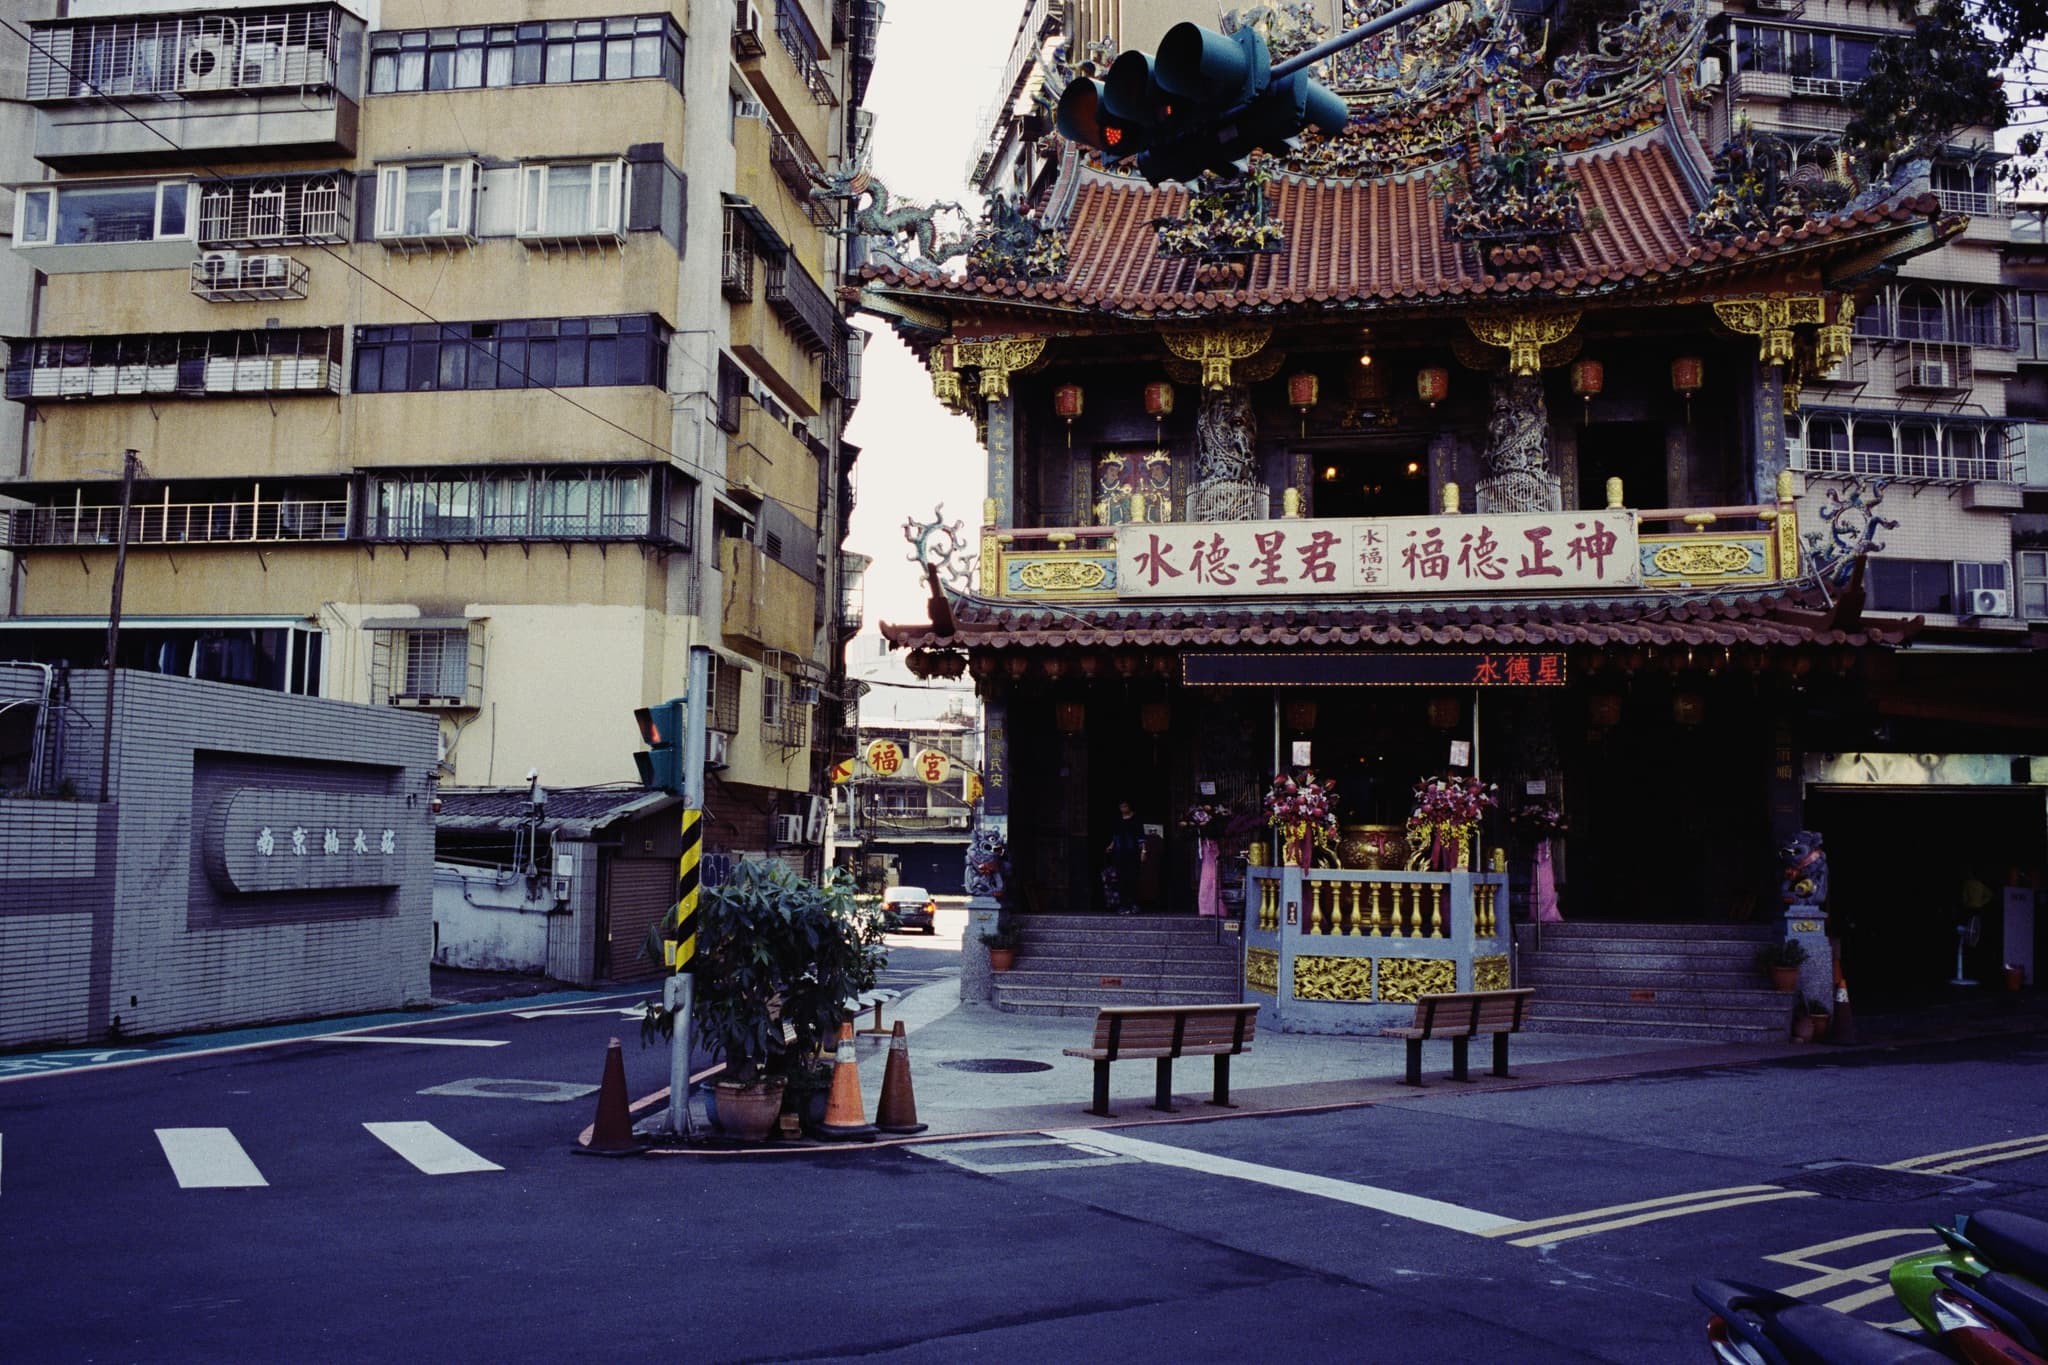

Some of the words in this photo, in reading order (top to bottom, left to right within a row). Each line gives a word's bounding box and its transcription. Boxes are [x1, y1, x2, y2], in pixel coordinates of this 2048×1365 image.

[1133, 530, 1342, 587] 水德星君
[1359, 528, 1384, 585] 水福宮
[1401, 520, 1618, 581] 福德正神
[1472, 655, 1562, 684] 水德星
[872, 744, 899, 773] 福
[922, 752, 946, 782] 宮
